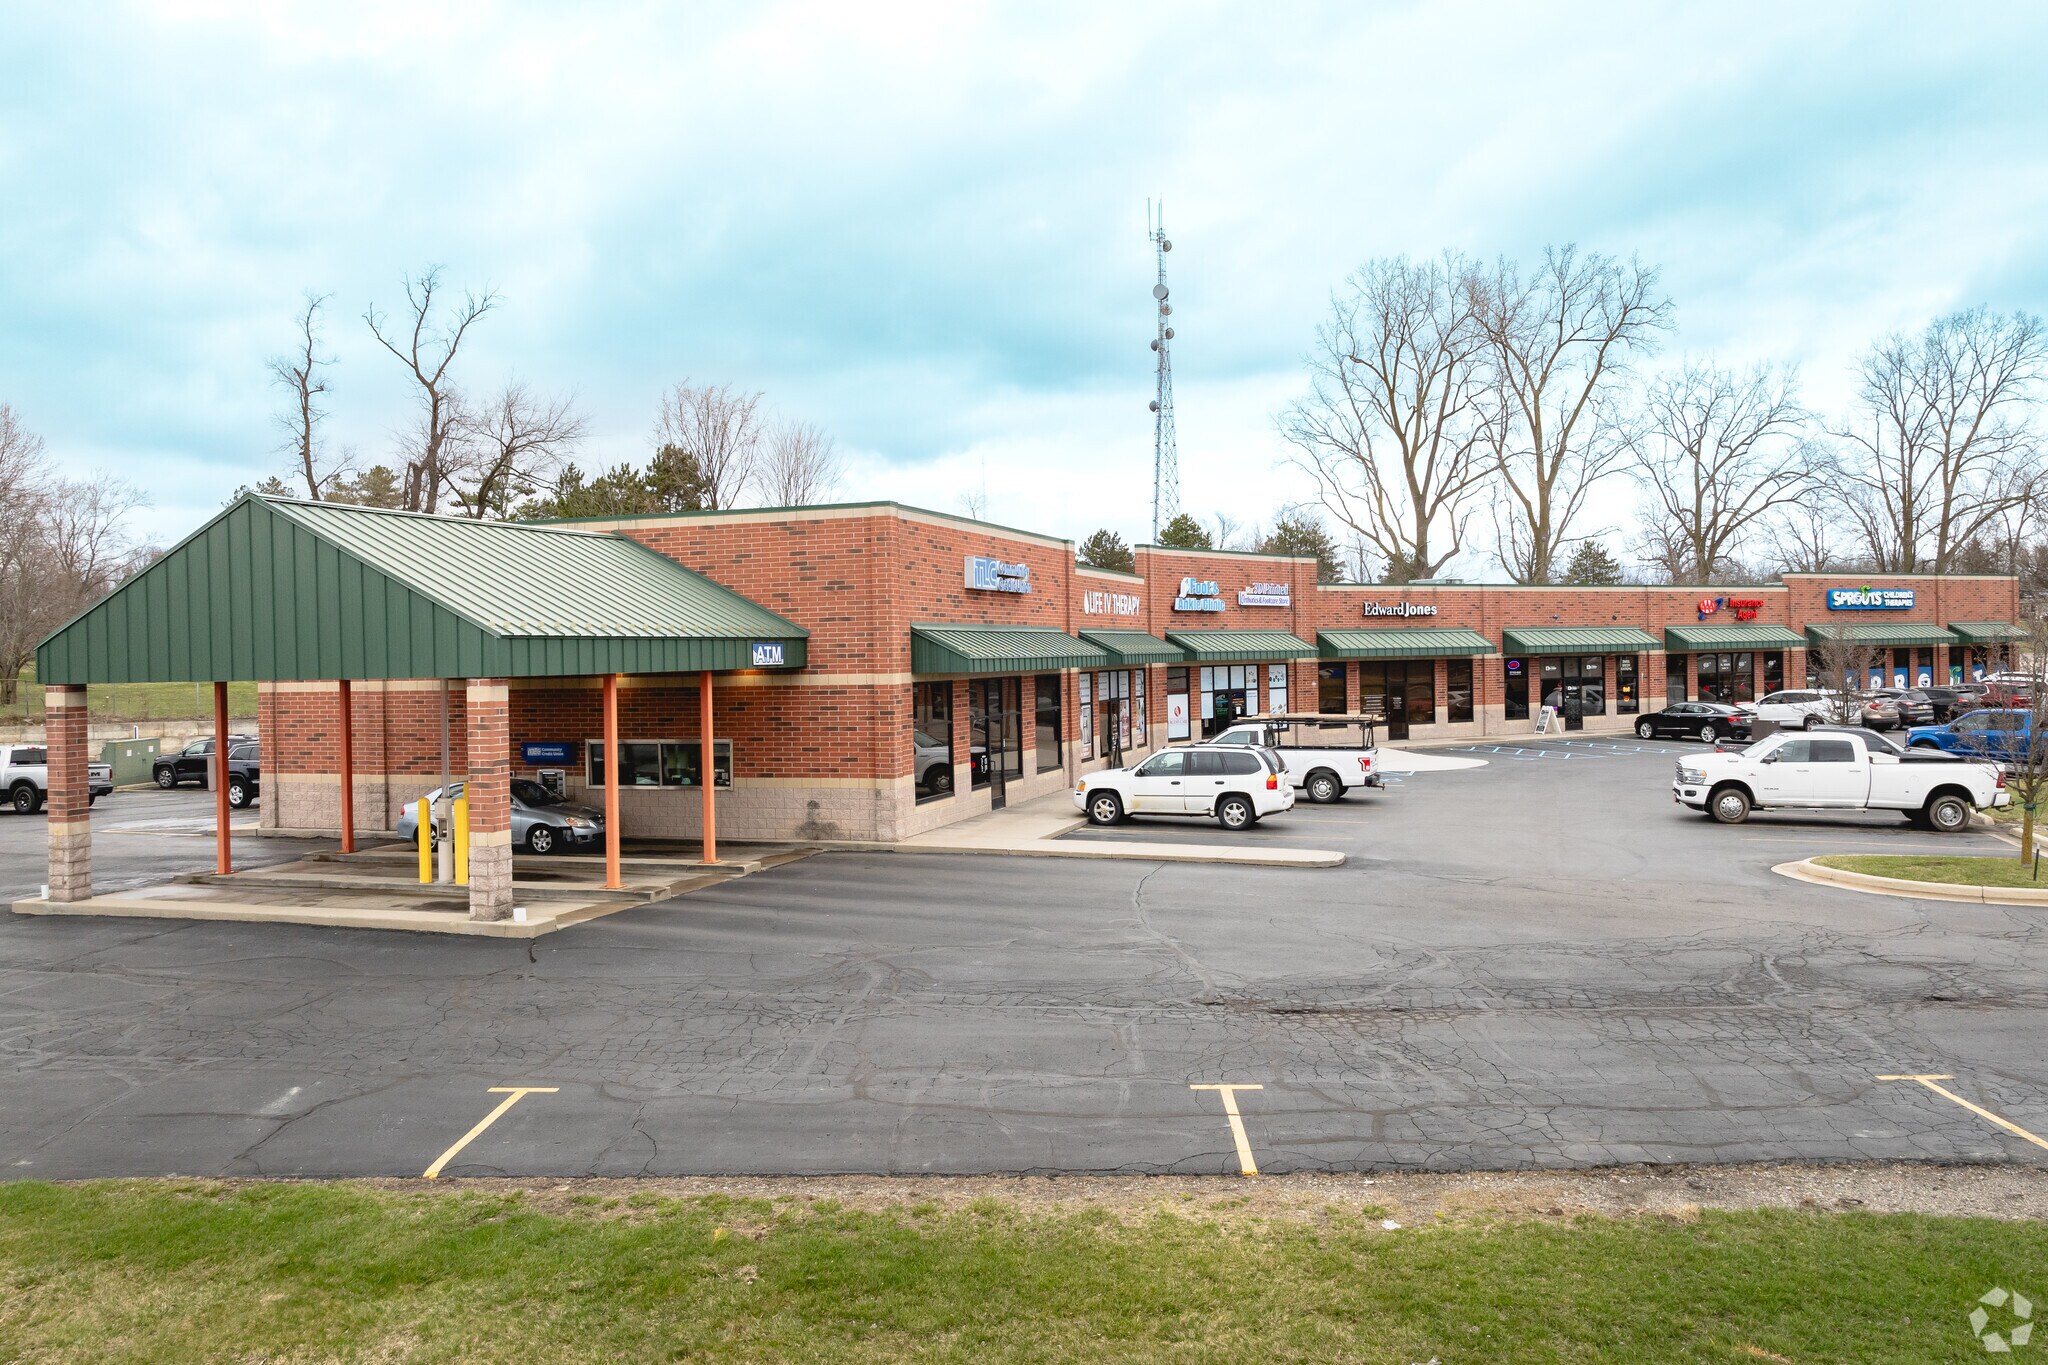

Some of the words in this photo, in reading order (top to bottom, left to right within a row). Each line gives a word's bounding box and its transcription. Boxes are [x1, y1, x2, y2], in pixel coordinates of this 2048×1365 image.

[1190, 578, 1212, 595] Foot
[1090, 592, 1102, 613] LIFE
[1113, 594, 1140, 616] THERAPY
[1177, 598, 1201, 610] Ankle
[1202, 598, 1225, 611] Clinic
[1730, 599, 1764, 607] Insurance
[1833, 591, 1882, 606] SPROUTS
[1738, 609, 1758, 621] Agent
[756, 645, 783, 663] ATM
